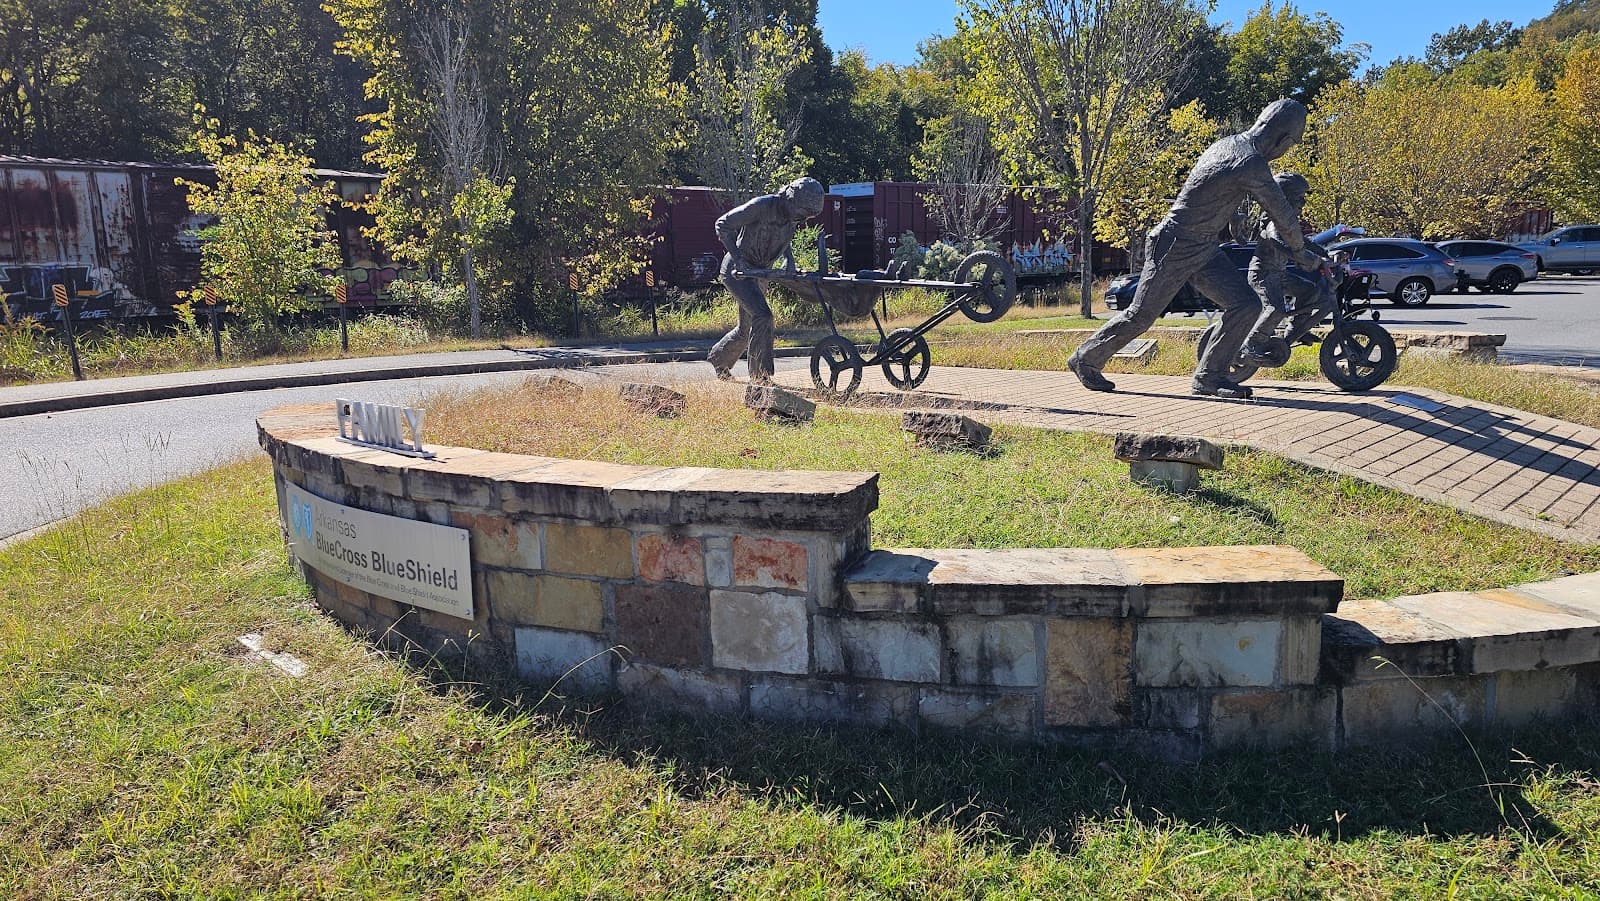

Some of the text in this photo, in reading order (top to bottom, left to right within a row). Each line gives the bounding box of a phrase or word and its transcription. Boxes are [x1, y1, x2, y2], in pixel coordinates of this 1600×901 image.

[336, 398, 426, 453] FAMILY
[316, 506, 357, 539] Arkansas
[316, 531, 368, 569] BlueCross
[371, 550, 459, 591] BlueShield
